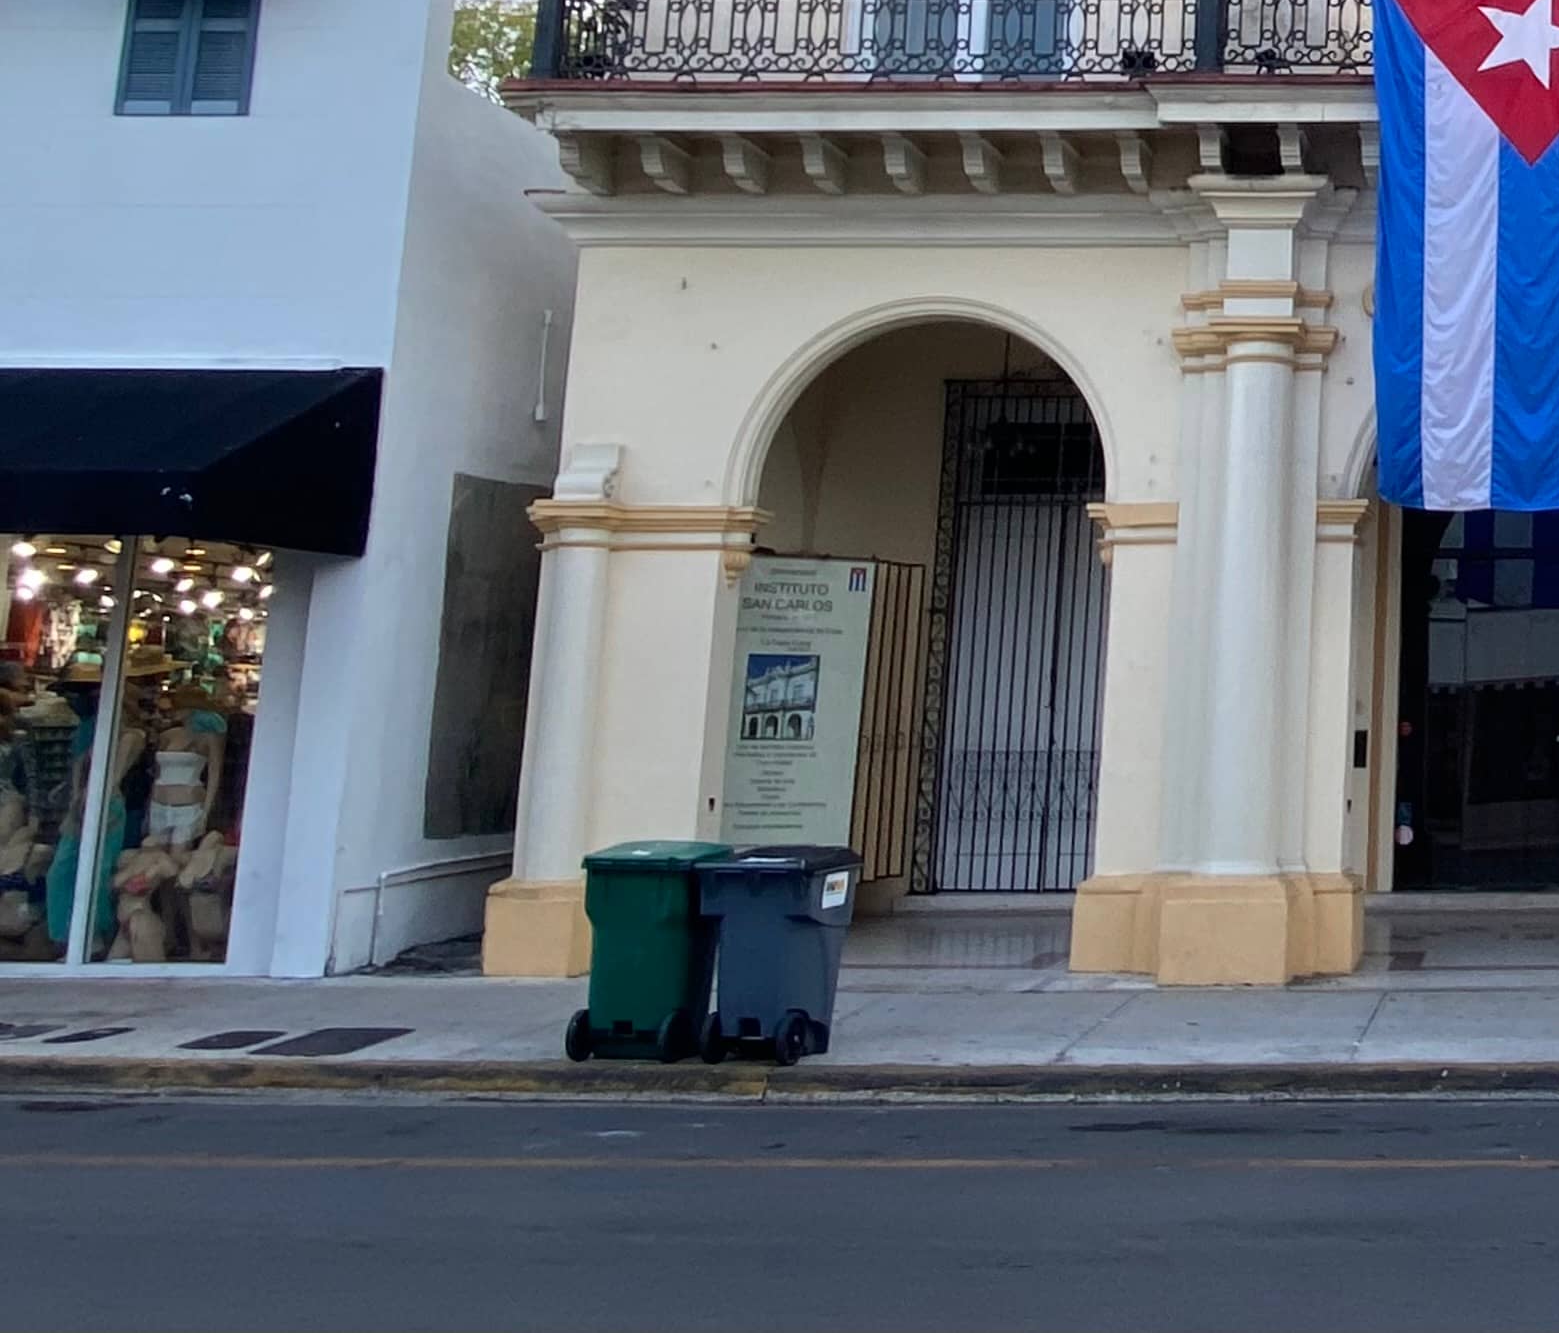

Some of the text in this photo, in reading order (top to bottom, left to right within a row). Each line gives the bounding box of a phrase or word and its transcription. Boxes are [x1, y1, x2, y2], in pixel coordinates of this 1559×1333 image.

[754, 582, 830, 596] INSTITUTO
[742, 597, 833, 613] SAN CARLOS
